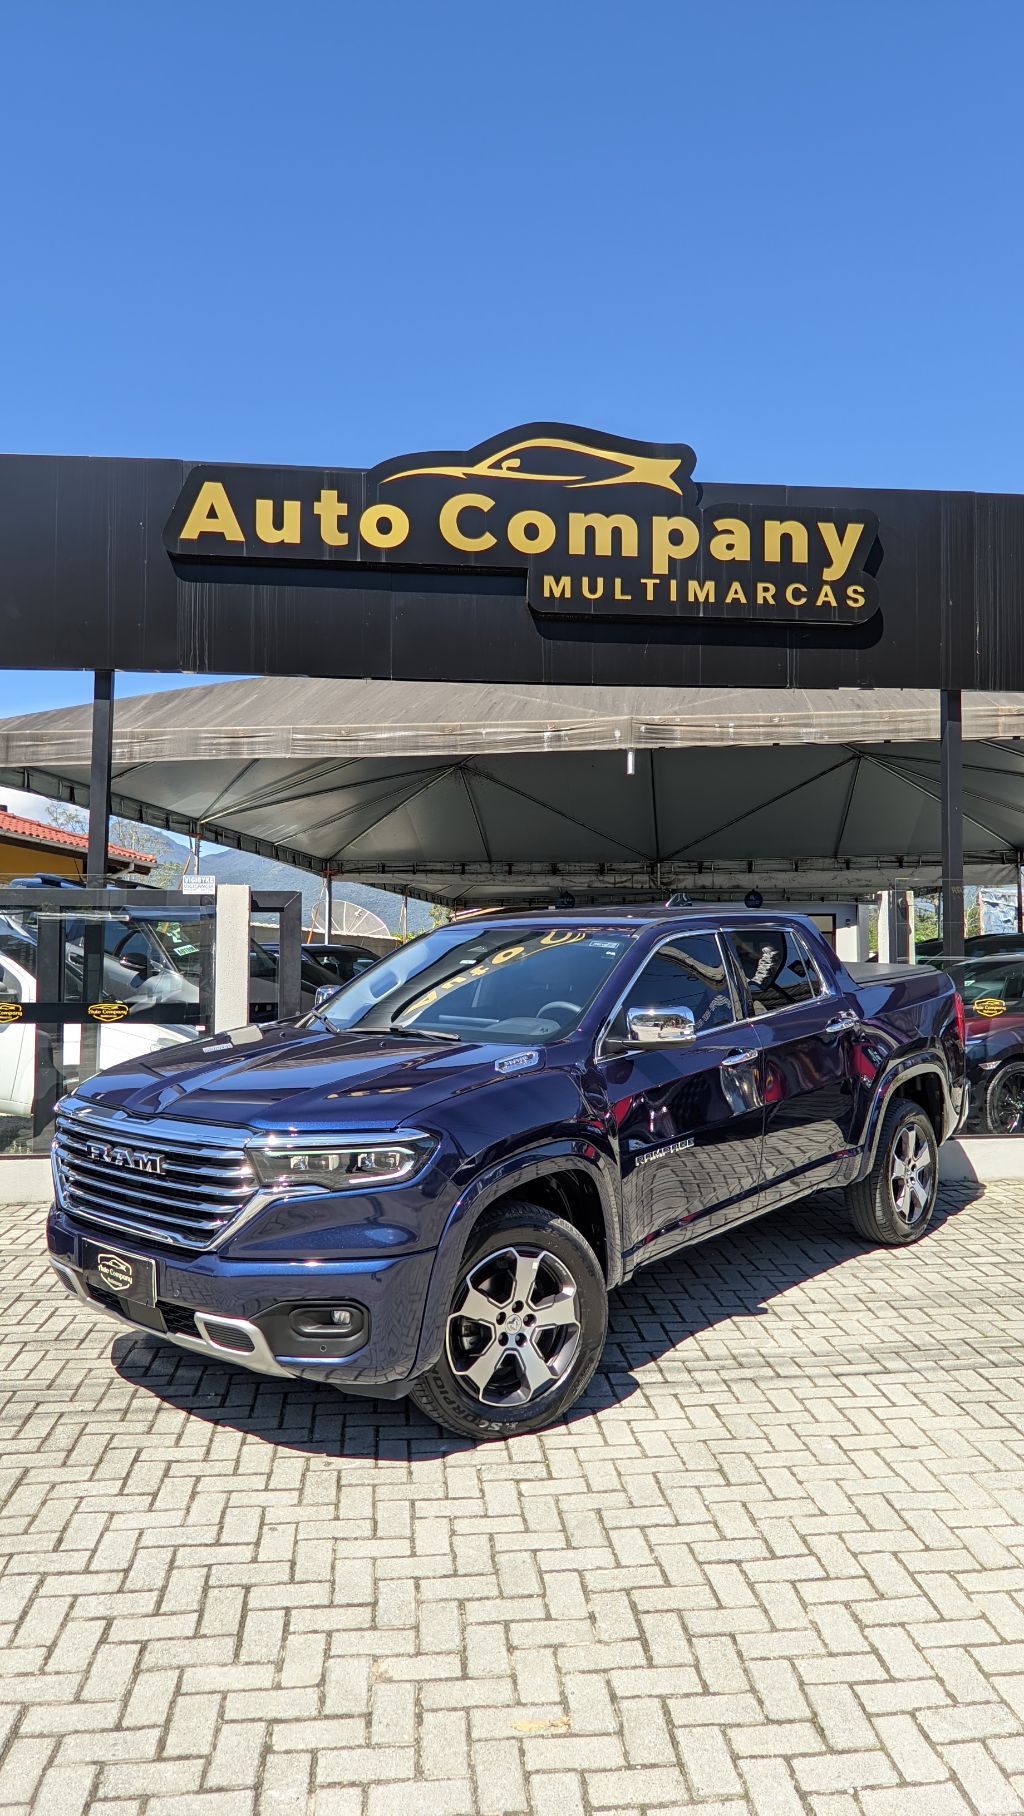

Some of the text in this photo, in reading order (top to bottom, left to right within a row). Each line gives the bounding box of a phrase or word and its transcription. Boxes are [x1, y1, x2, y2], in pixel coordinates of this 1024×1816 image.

[180, 481, 865, 582] Auto Company
[543, 575, 866, 608] MULTIMARCAS
[86, 1139, 166, 1175] RAM
[635, 1137, 695, 1167] RAMPAGE
